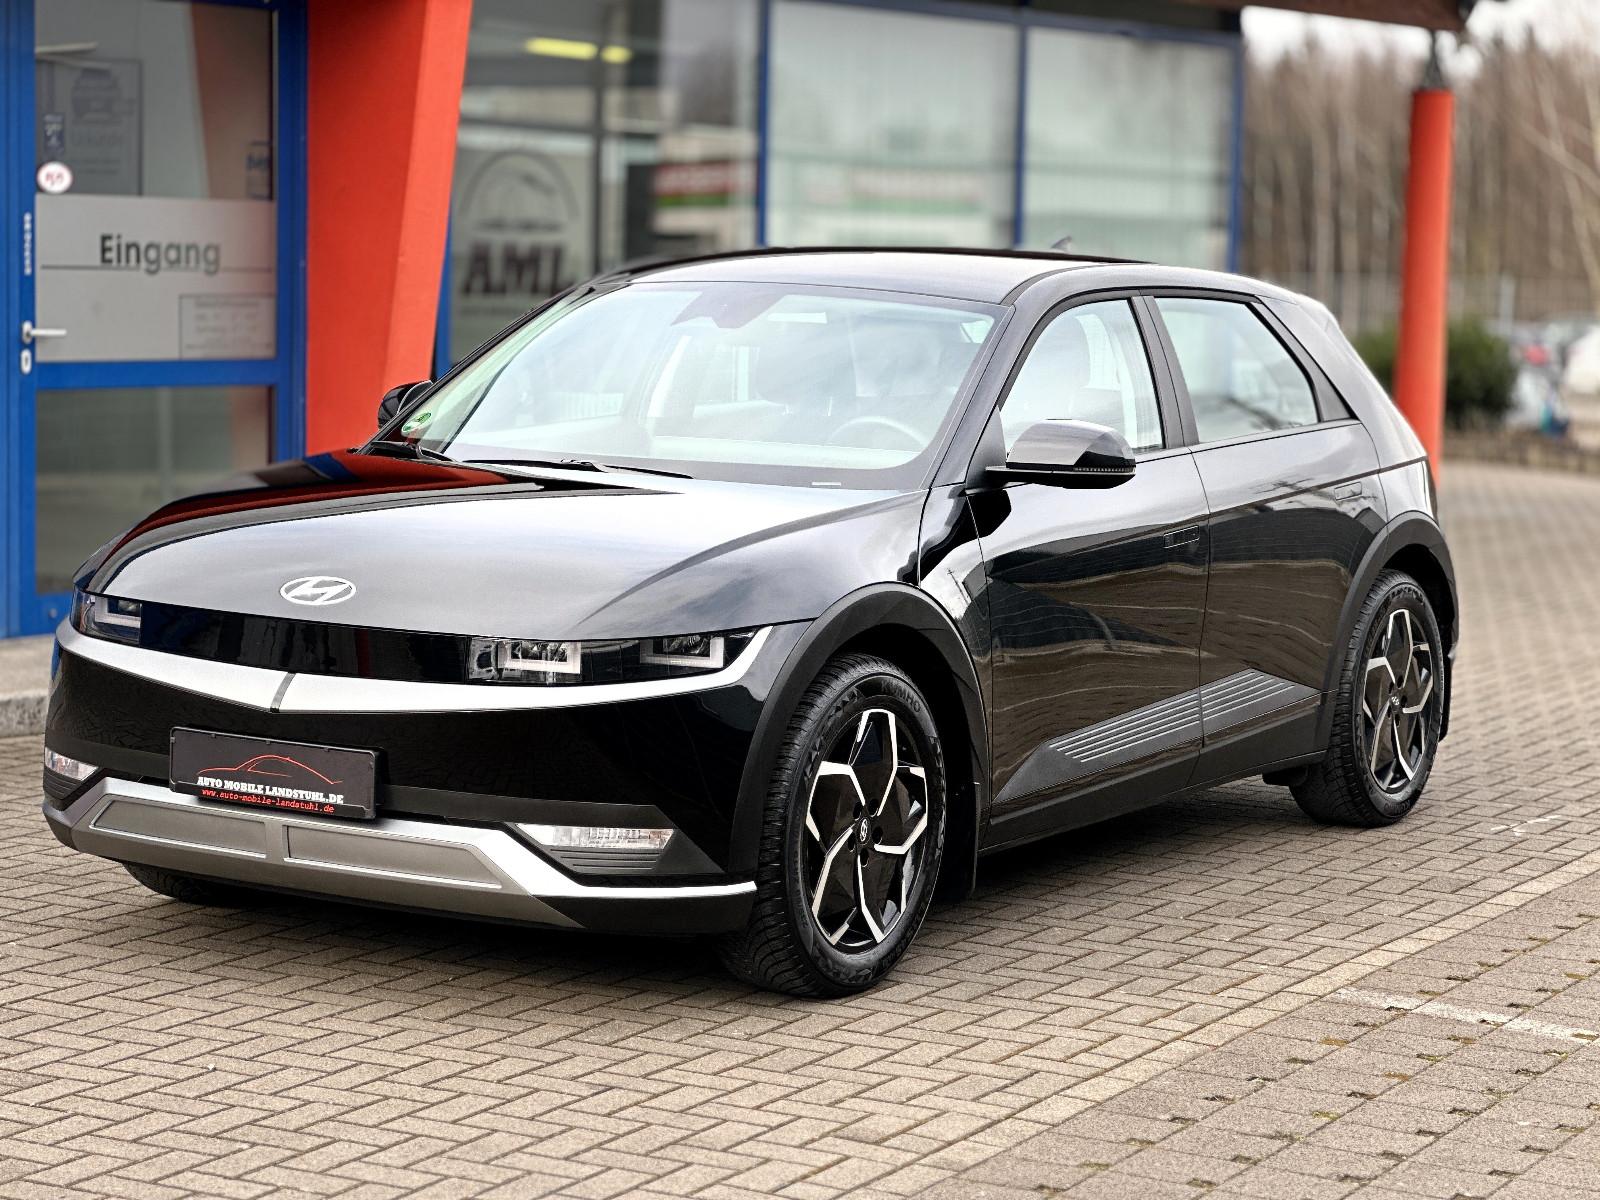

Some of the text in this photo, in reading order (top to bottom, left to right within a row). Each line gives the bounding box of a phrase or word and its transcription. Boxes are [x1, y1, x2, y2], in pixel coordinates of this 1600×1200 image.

[100, 233, 221, 276] Eingang
[464, 242, 575, 297] AML
[880, 678, 921, 713] KUMHO
[197, 776, 344, 804] AUTO MOBILE LANDSTUHL.DE
[201, 788, 335, 813] www.auto-mobile-landstuhl.de
